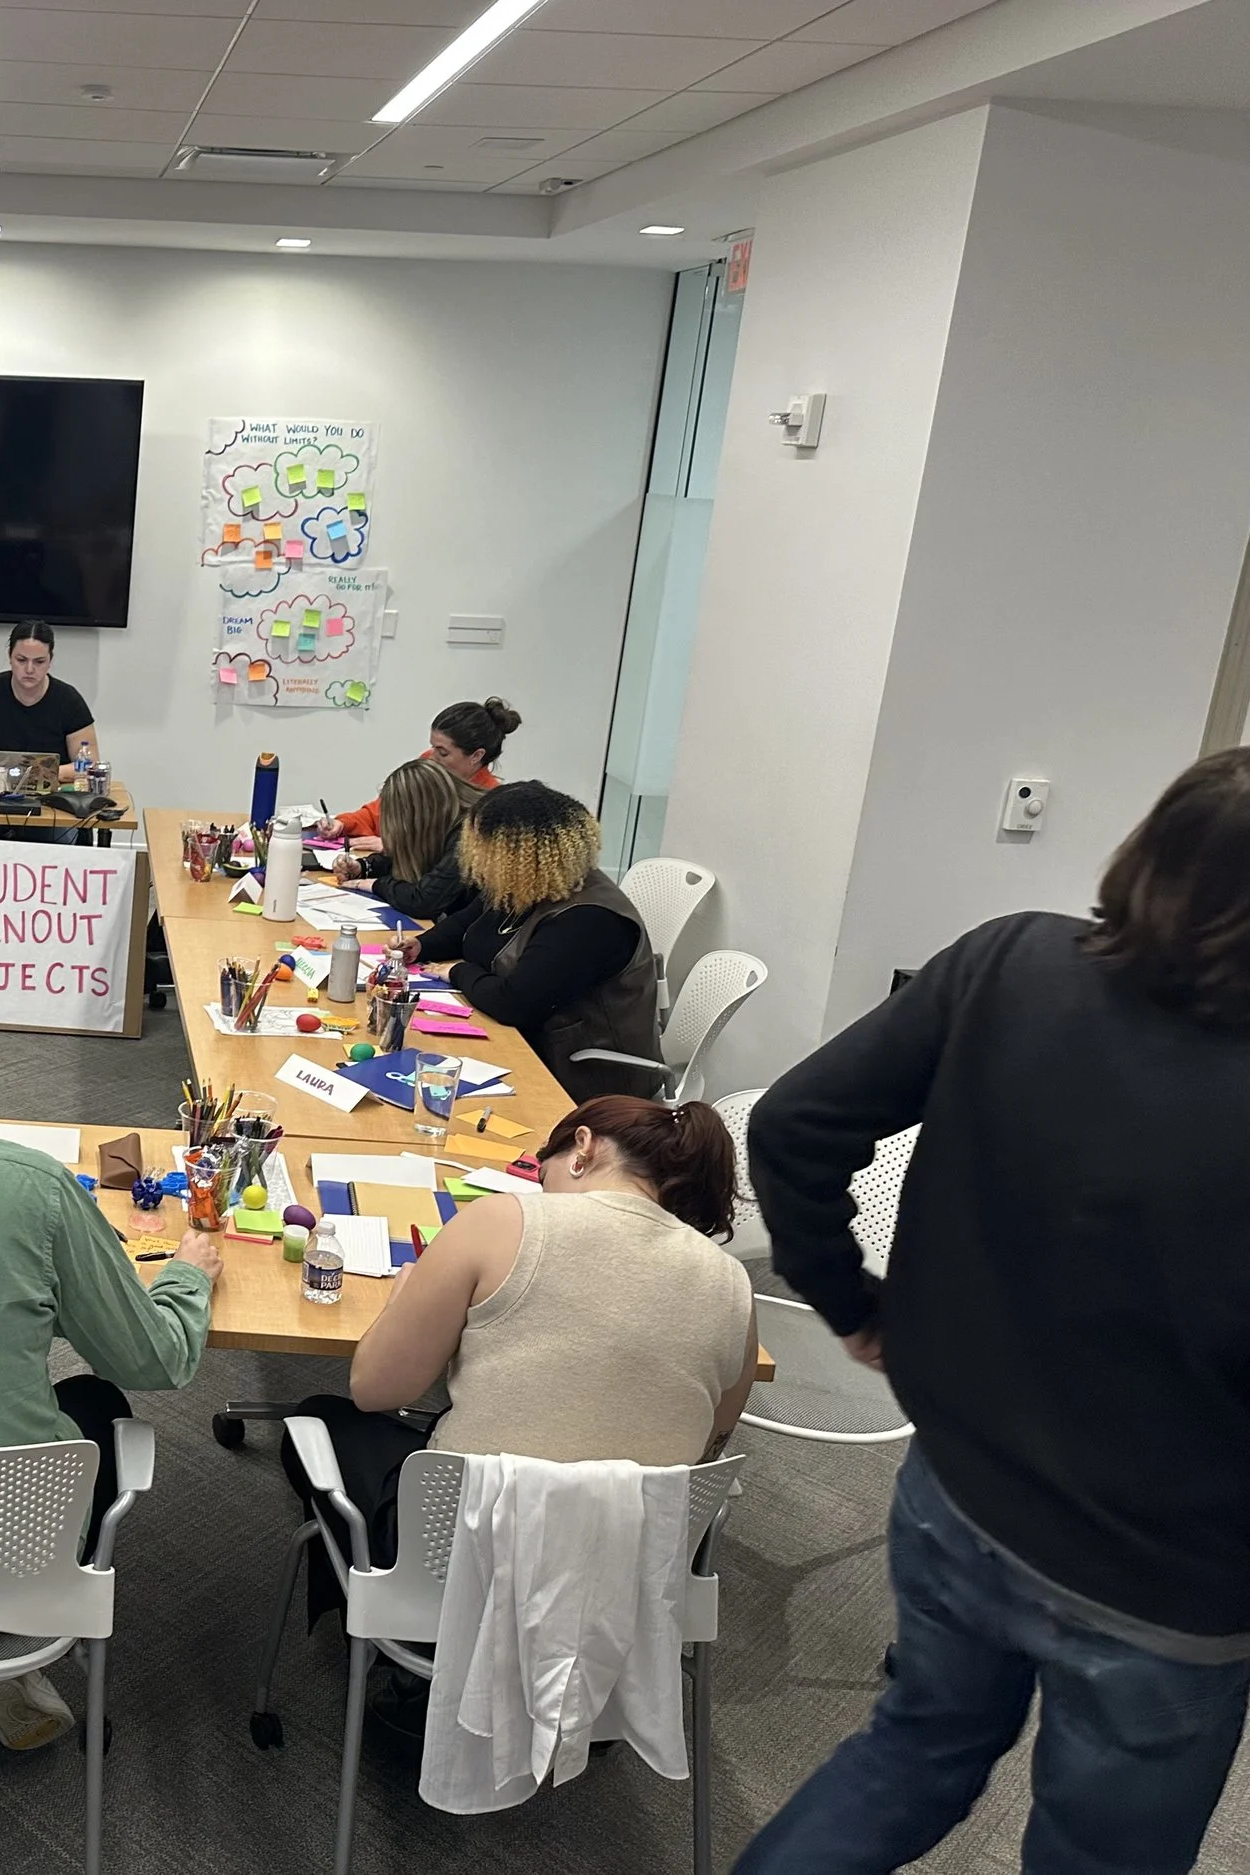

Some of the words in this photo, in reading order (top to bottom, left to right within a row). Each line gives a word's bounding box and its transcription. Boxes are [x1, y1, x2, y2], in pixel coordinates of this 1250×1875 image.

[250, 423, 277, 433] WHAT
[286, 424, 319, 434] WOULD
[324, 424, 343, 436] YOU
[350, 428, 364, 438] DO
[241, 434, 279, 444] WITHOUT
[284, 436, 318, 445] LIMITS?
[328, 575, 357, 584] REALLY
[222, 616, 253, 625] DREAM
[227, 625, 242, 634] BIG
[296, 1070, 335, 1096] LAURA
